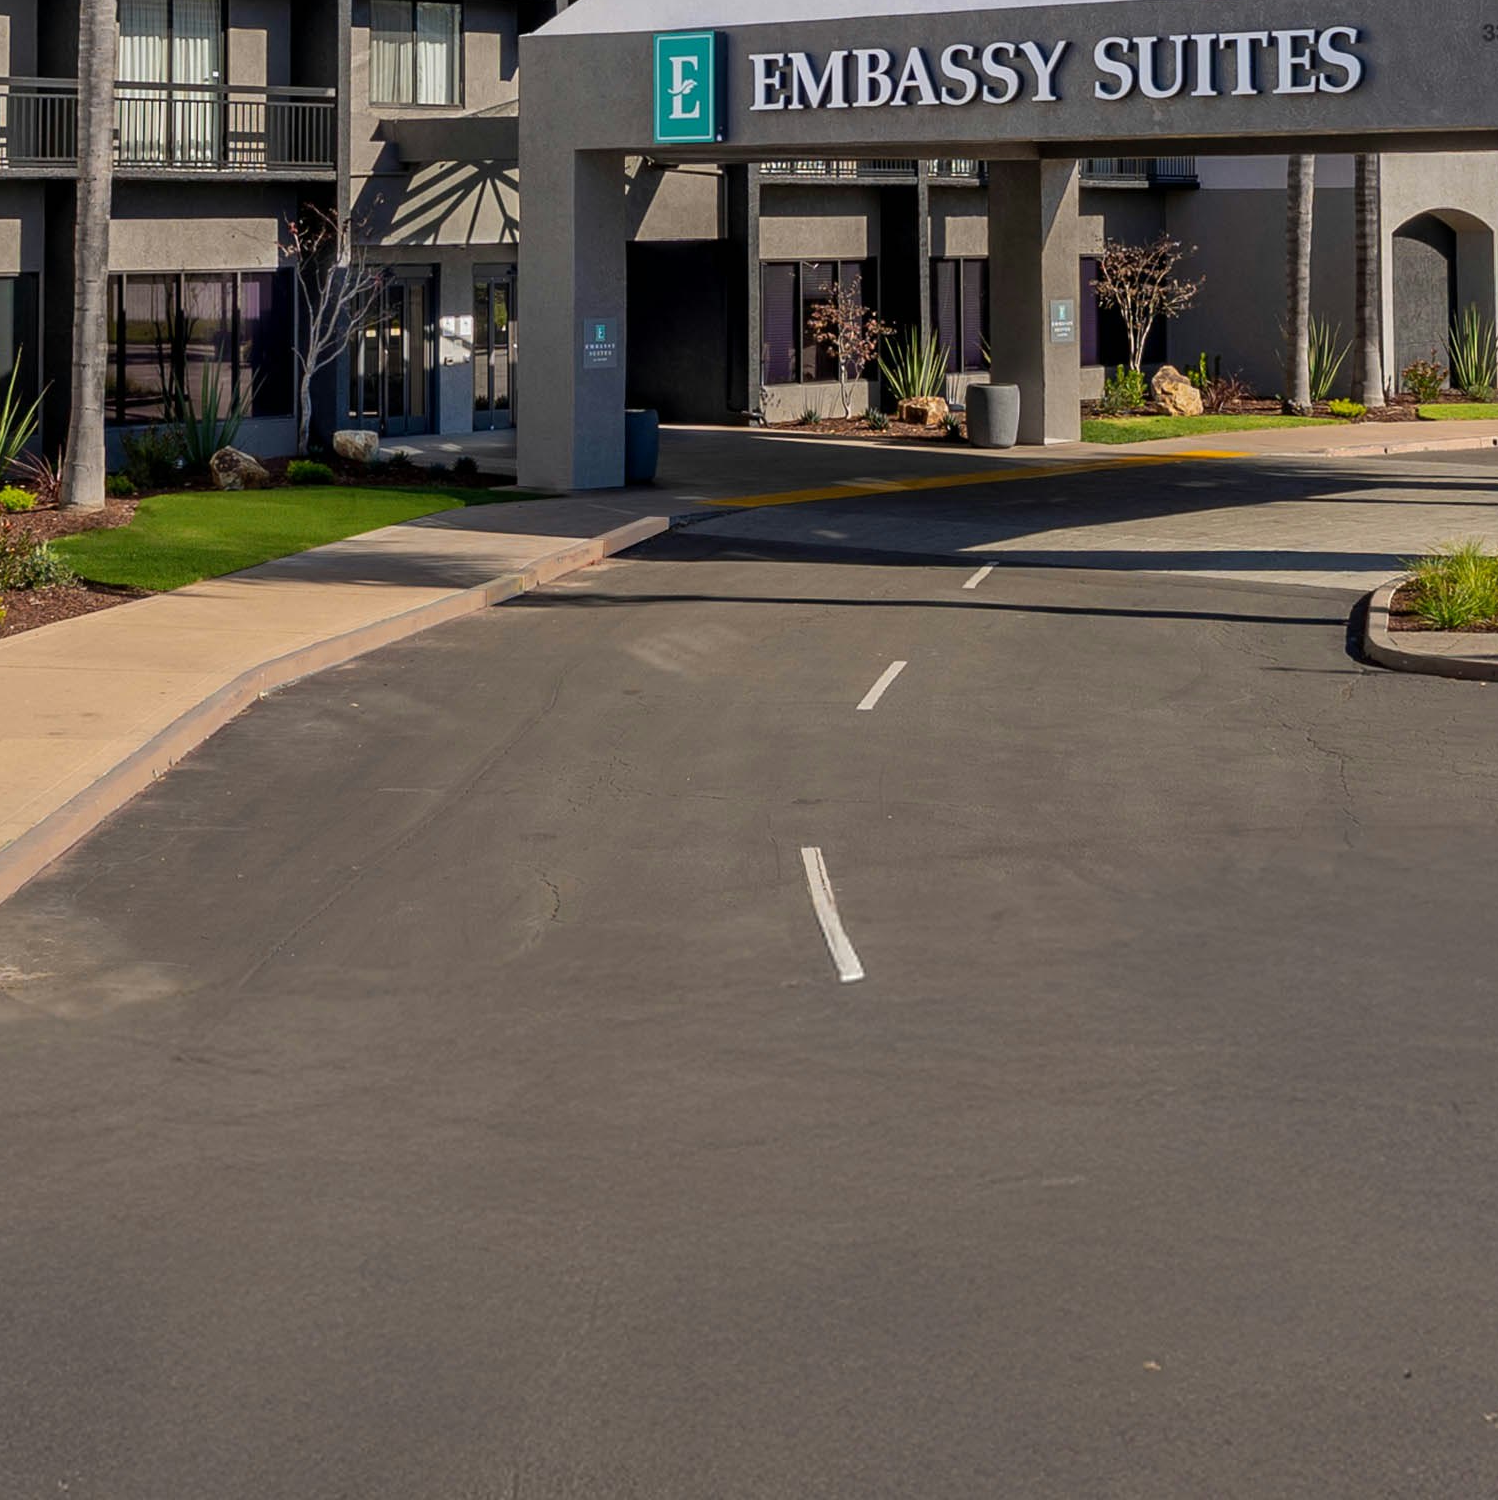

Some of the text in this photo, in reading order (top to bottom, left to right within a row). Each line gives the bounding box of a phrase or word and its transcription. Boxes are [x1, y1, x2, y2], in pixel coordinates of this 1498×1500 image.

[667, 55, 701, 119] E
[748, 25, 1362, 111] EMBASSY SUITES
